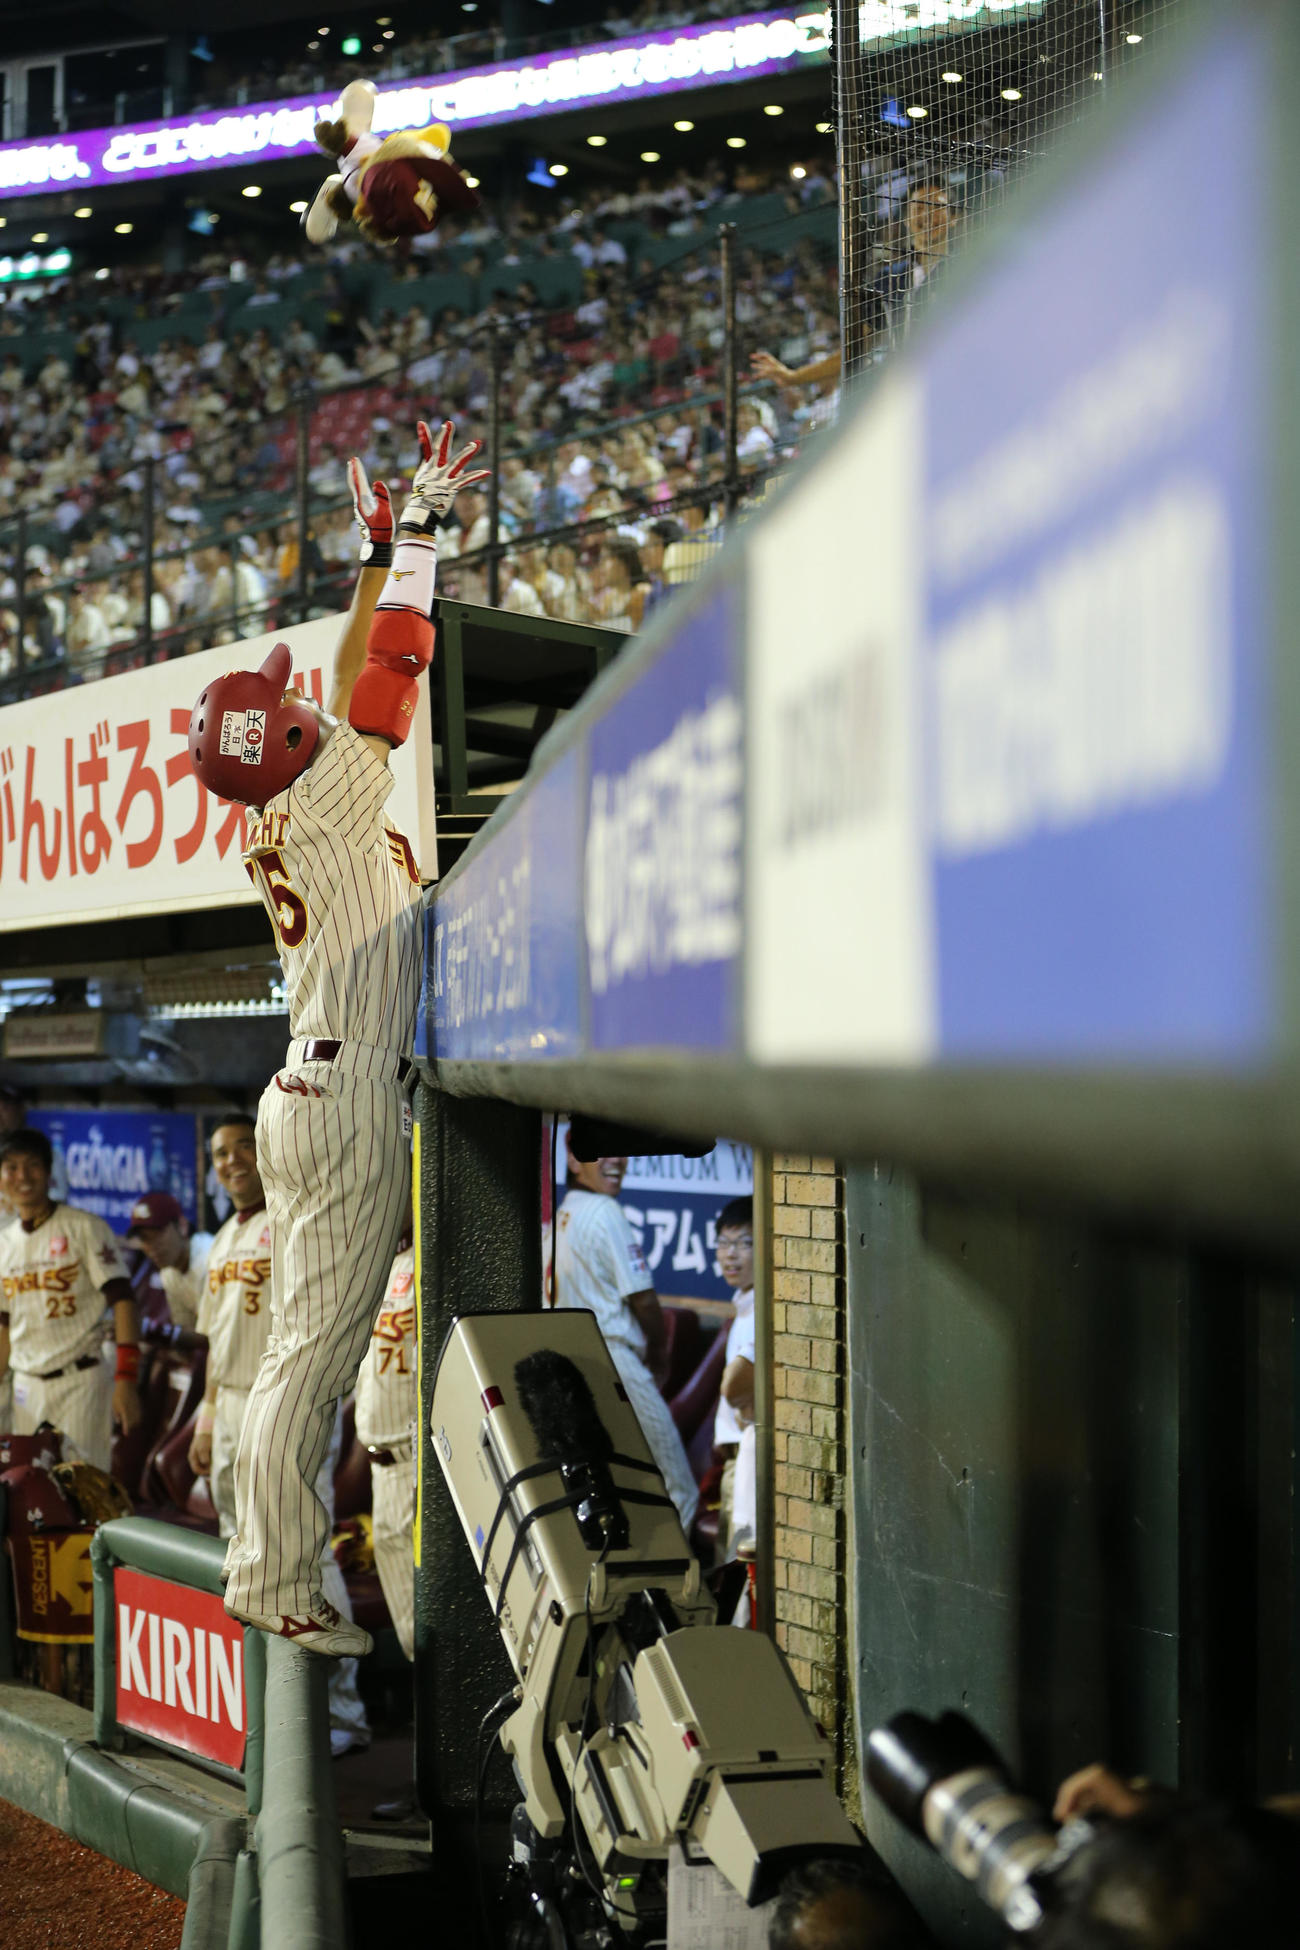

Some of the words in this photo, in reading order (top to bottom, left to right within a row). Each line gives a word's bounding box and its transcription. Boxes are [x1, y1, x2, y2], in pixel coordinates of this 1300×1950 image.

[46, 1296, 76, 1319] 23
[244, 1291, 260, 1316] 3
[378, 1347, 409, 1374] 71
[119, 1604, 243, 1733] KIRIN
